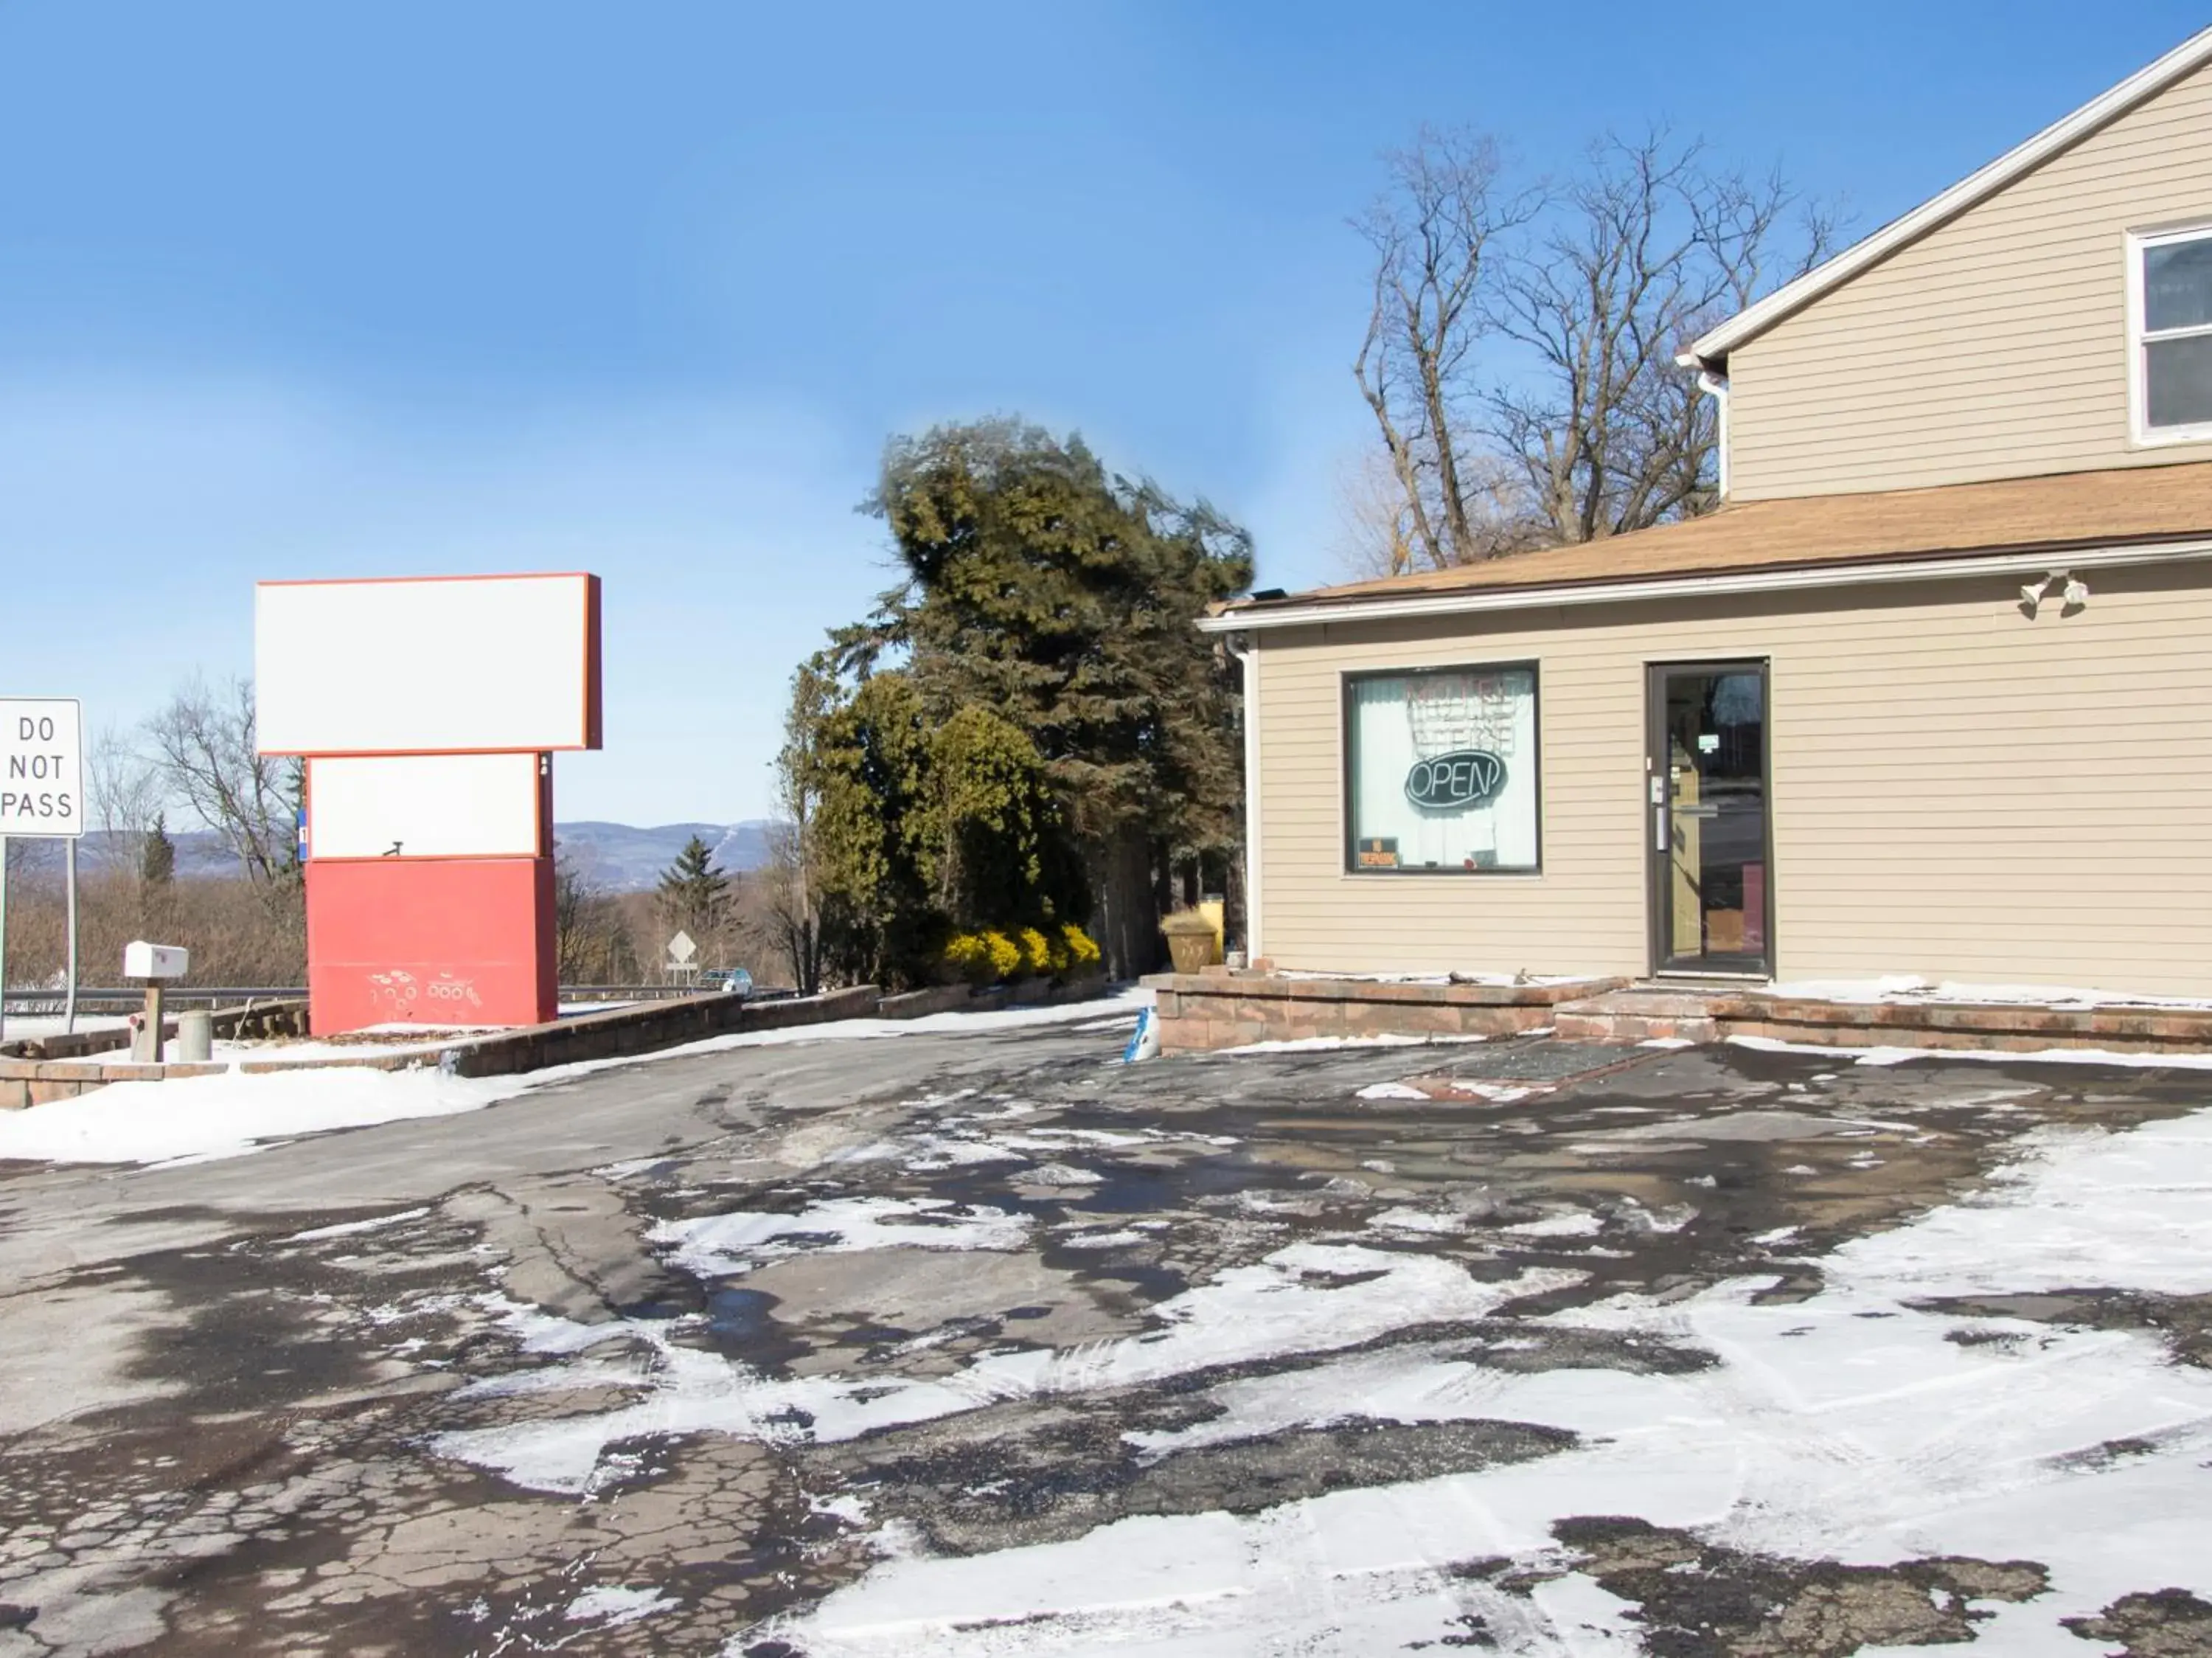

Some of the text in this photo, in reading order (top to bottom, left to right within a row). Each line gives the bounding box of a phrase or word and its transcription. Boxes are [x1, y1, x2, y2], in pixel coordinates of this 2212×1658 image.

[19, 717, 55, 741] DO
[10, 755, 64, 780] NOT
[1409, 761, 1492, 797] OPEN
[1, 793, 72, 817] PASS
